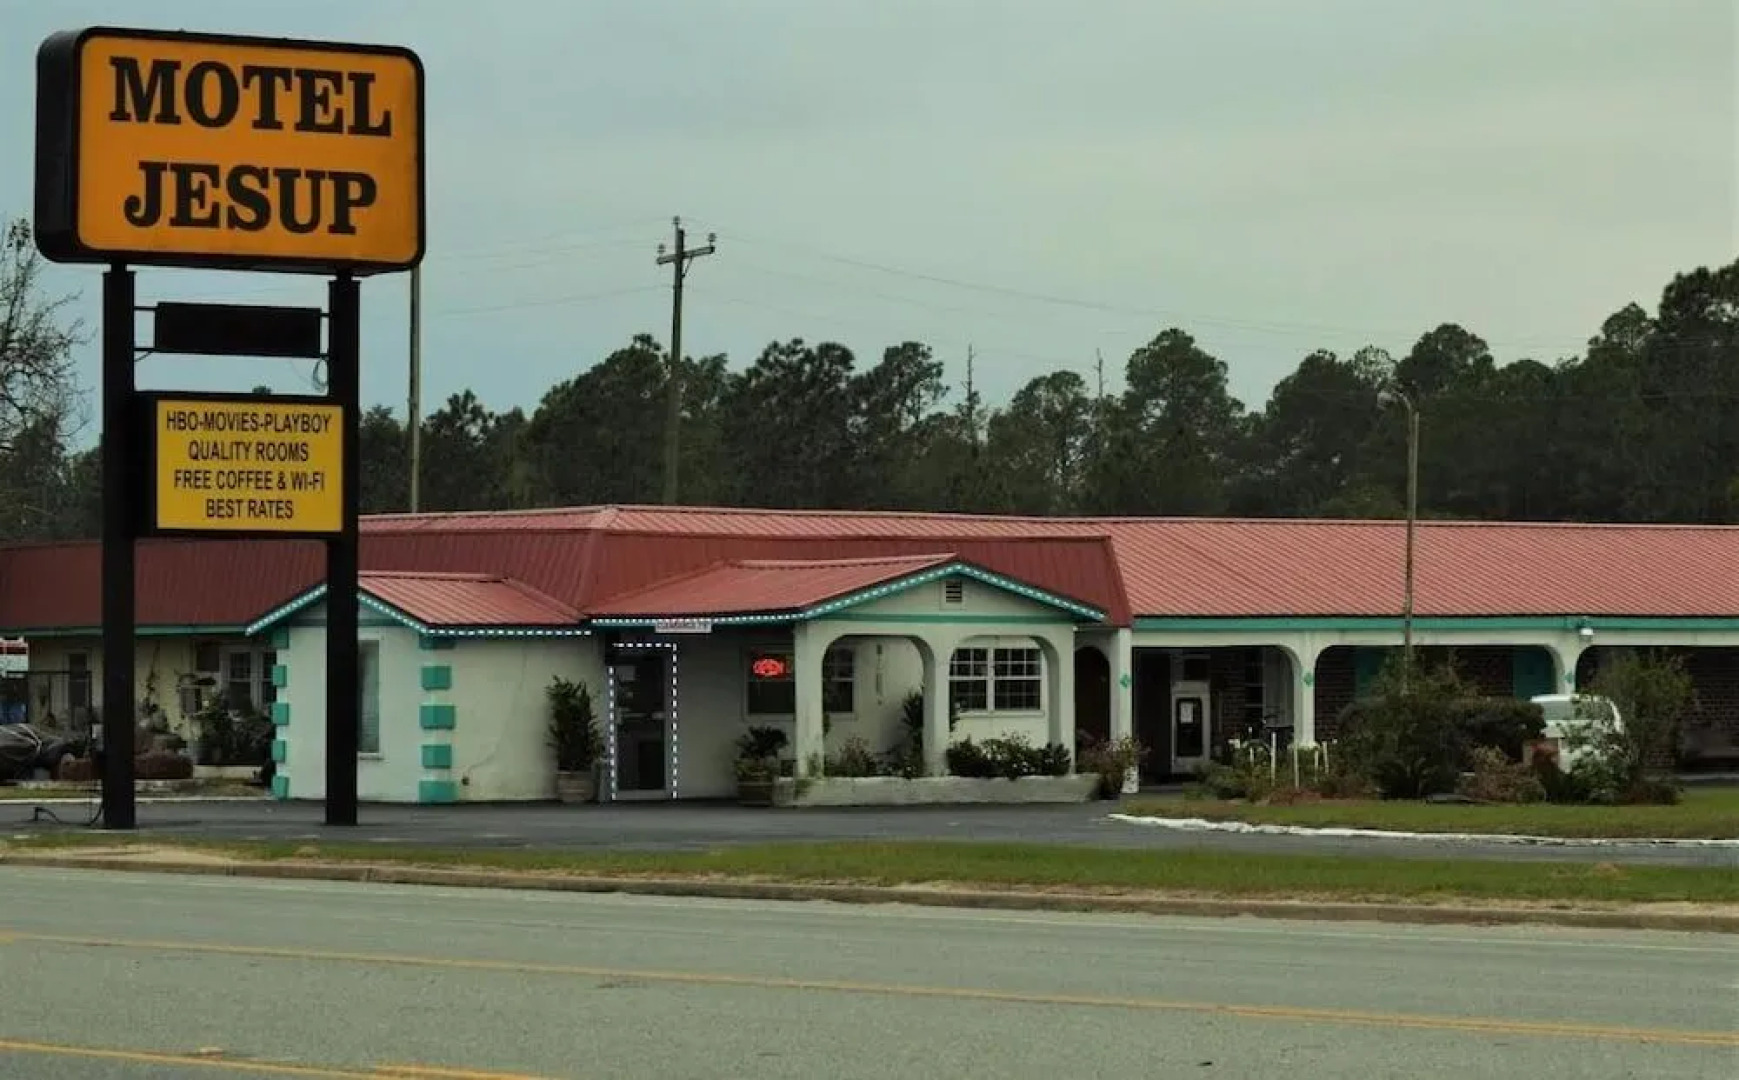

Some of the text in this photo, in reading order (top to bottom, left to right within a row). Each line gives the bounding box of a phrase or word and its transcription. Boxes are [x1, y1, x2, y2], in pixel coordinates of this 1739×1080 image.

[109, 56, 392, 137] MOTEL
[123, 160, 377, 236] JESUP
[166, 410, 332, 434] HBO-MOVIES-PLAYBOY
[188, 439, 309, 462] QUALITY ROOMS
[174, 469, 326, 492] FREE COFFEE & WI-FI
[206, 498, 293, 519] BEST RATES
